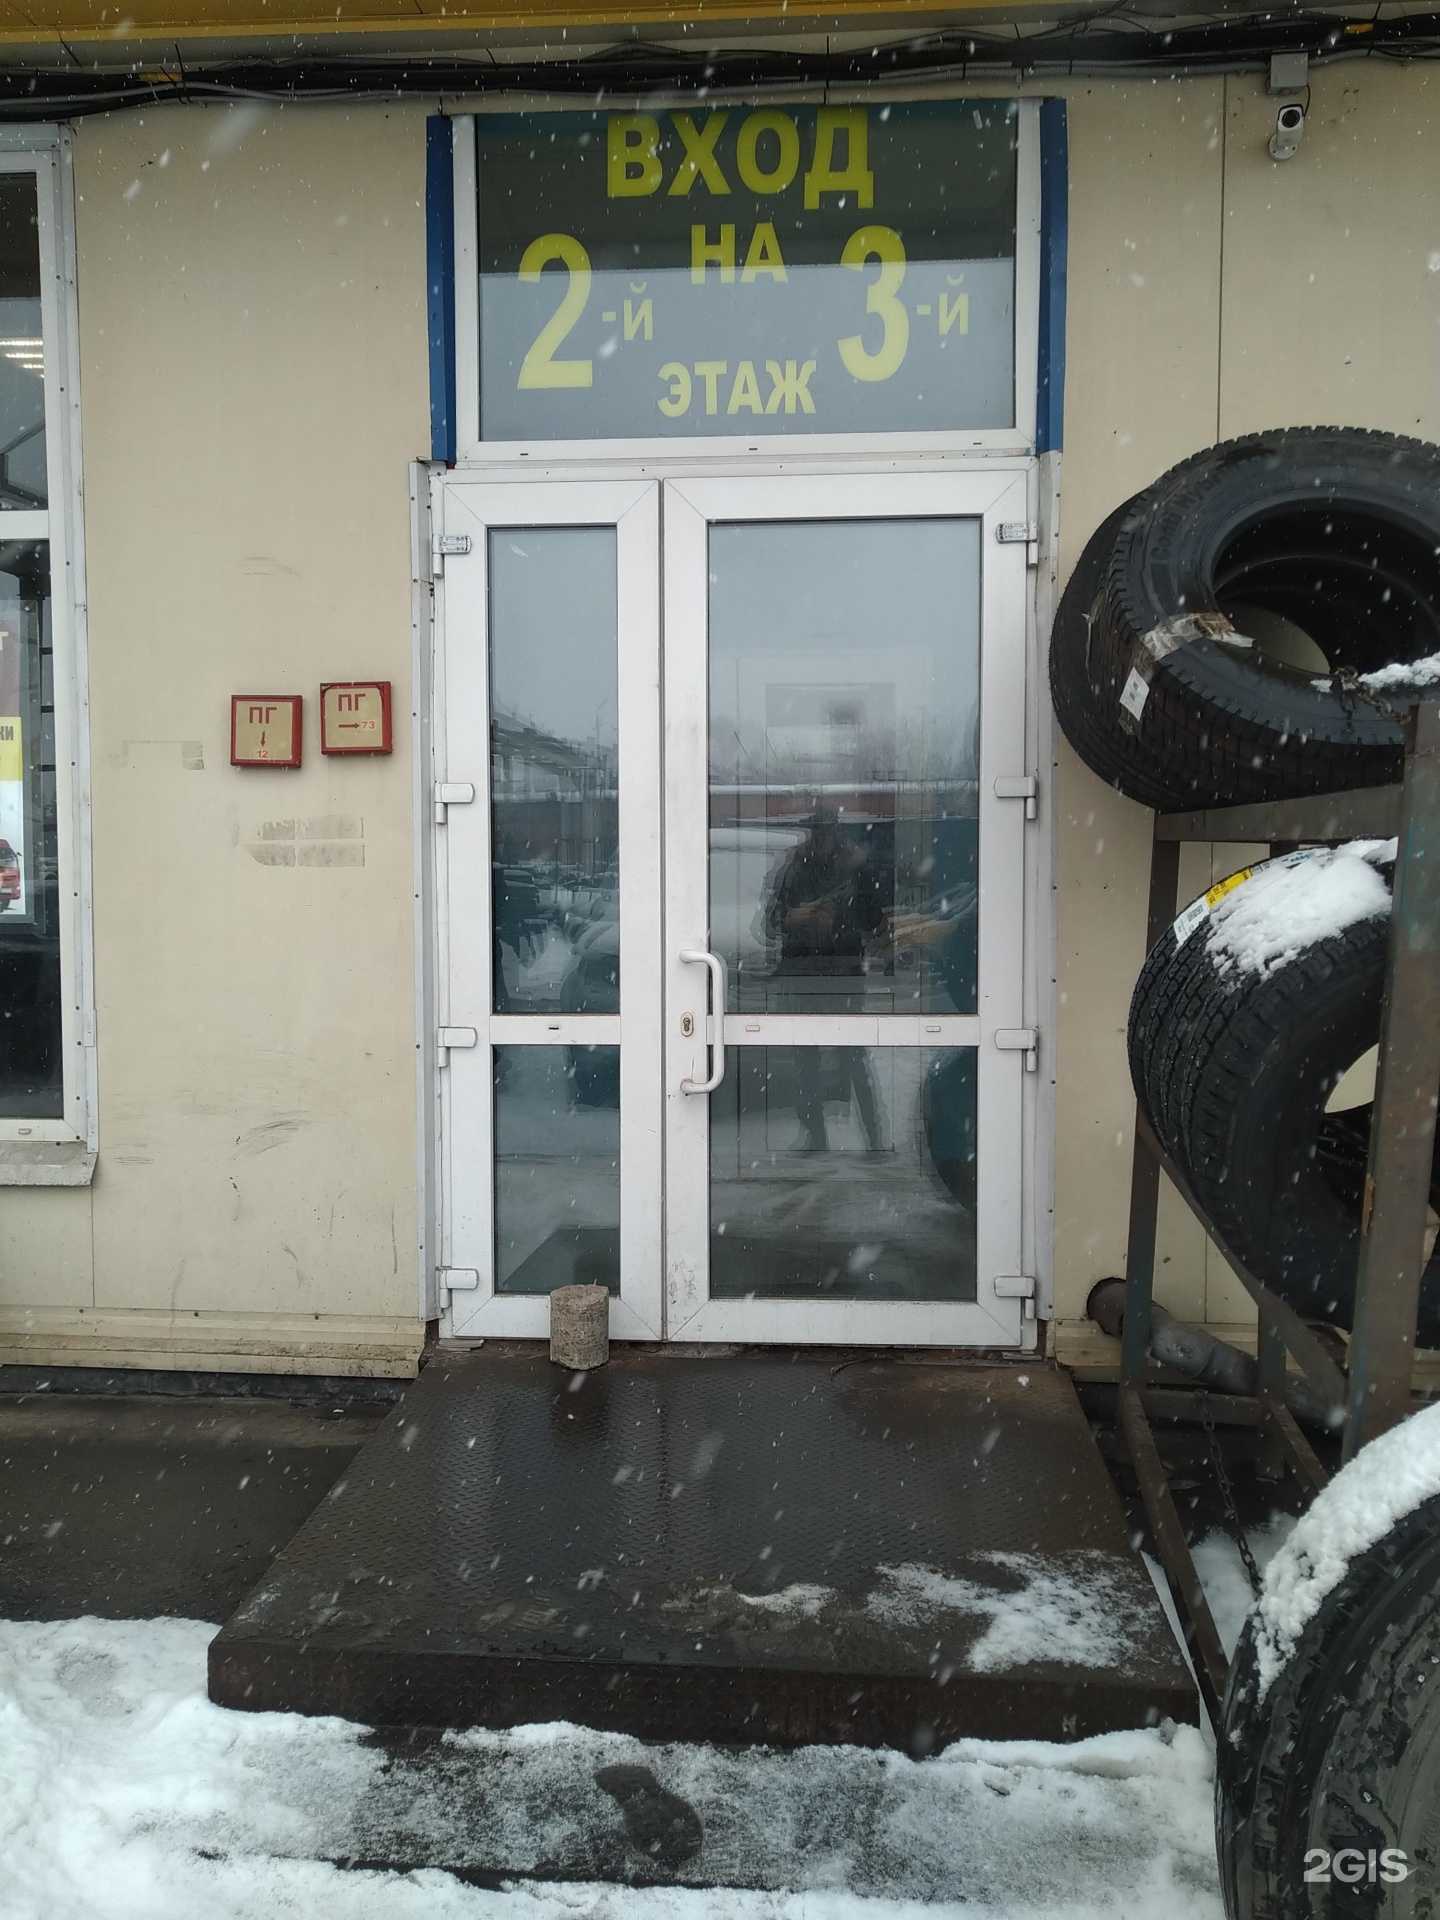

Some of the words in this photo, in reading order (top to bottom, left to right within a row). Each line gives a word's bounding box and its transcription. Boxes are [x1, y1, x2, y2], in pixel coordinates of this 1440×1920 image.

[607, 107, 874, 210] ВХОД
[691, 222, 789, 285] НА
[657, 359, 817, 418] ЭТАЖ
[249, 706, 278, 724] ПГ
[338, 694, 366, 711] ПГ
